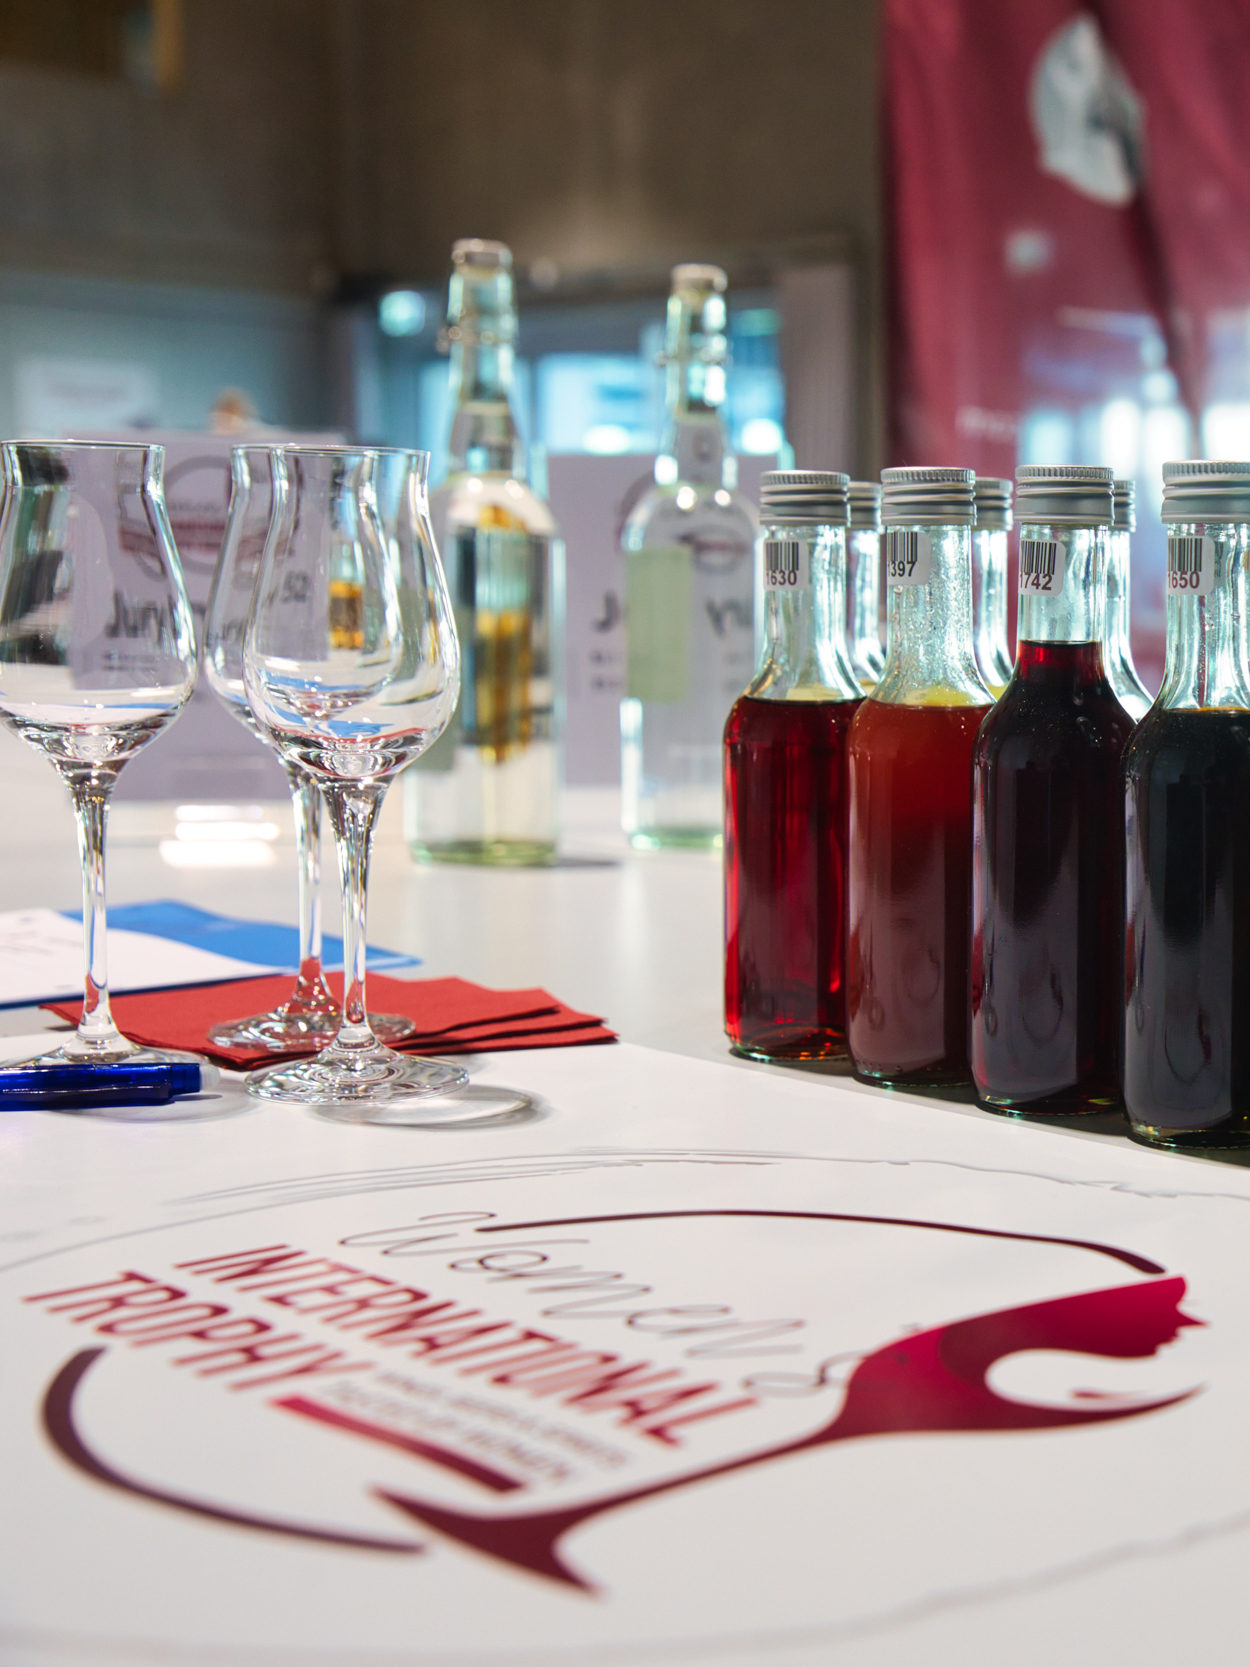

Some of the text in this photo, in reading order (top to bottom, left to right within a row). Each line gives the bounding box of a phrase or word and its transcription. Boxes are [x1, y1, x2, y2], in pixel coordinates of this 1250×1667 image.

[766, 570, 797, 586] 1630
[1020, 571, 1052, 591] 1742
[1168, 571, 1200, 589] 1650
[20, 1270, 377, 1388] TROPHY
[172, 1243, 760, 1447] INTERNATIONAL
